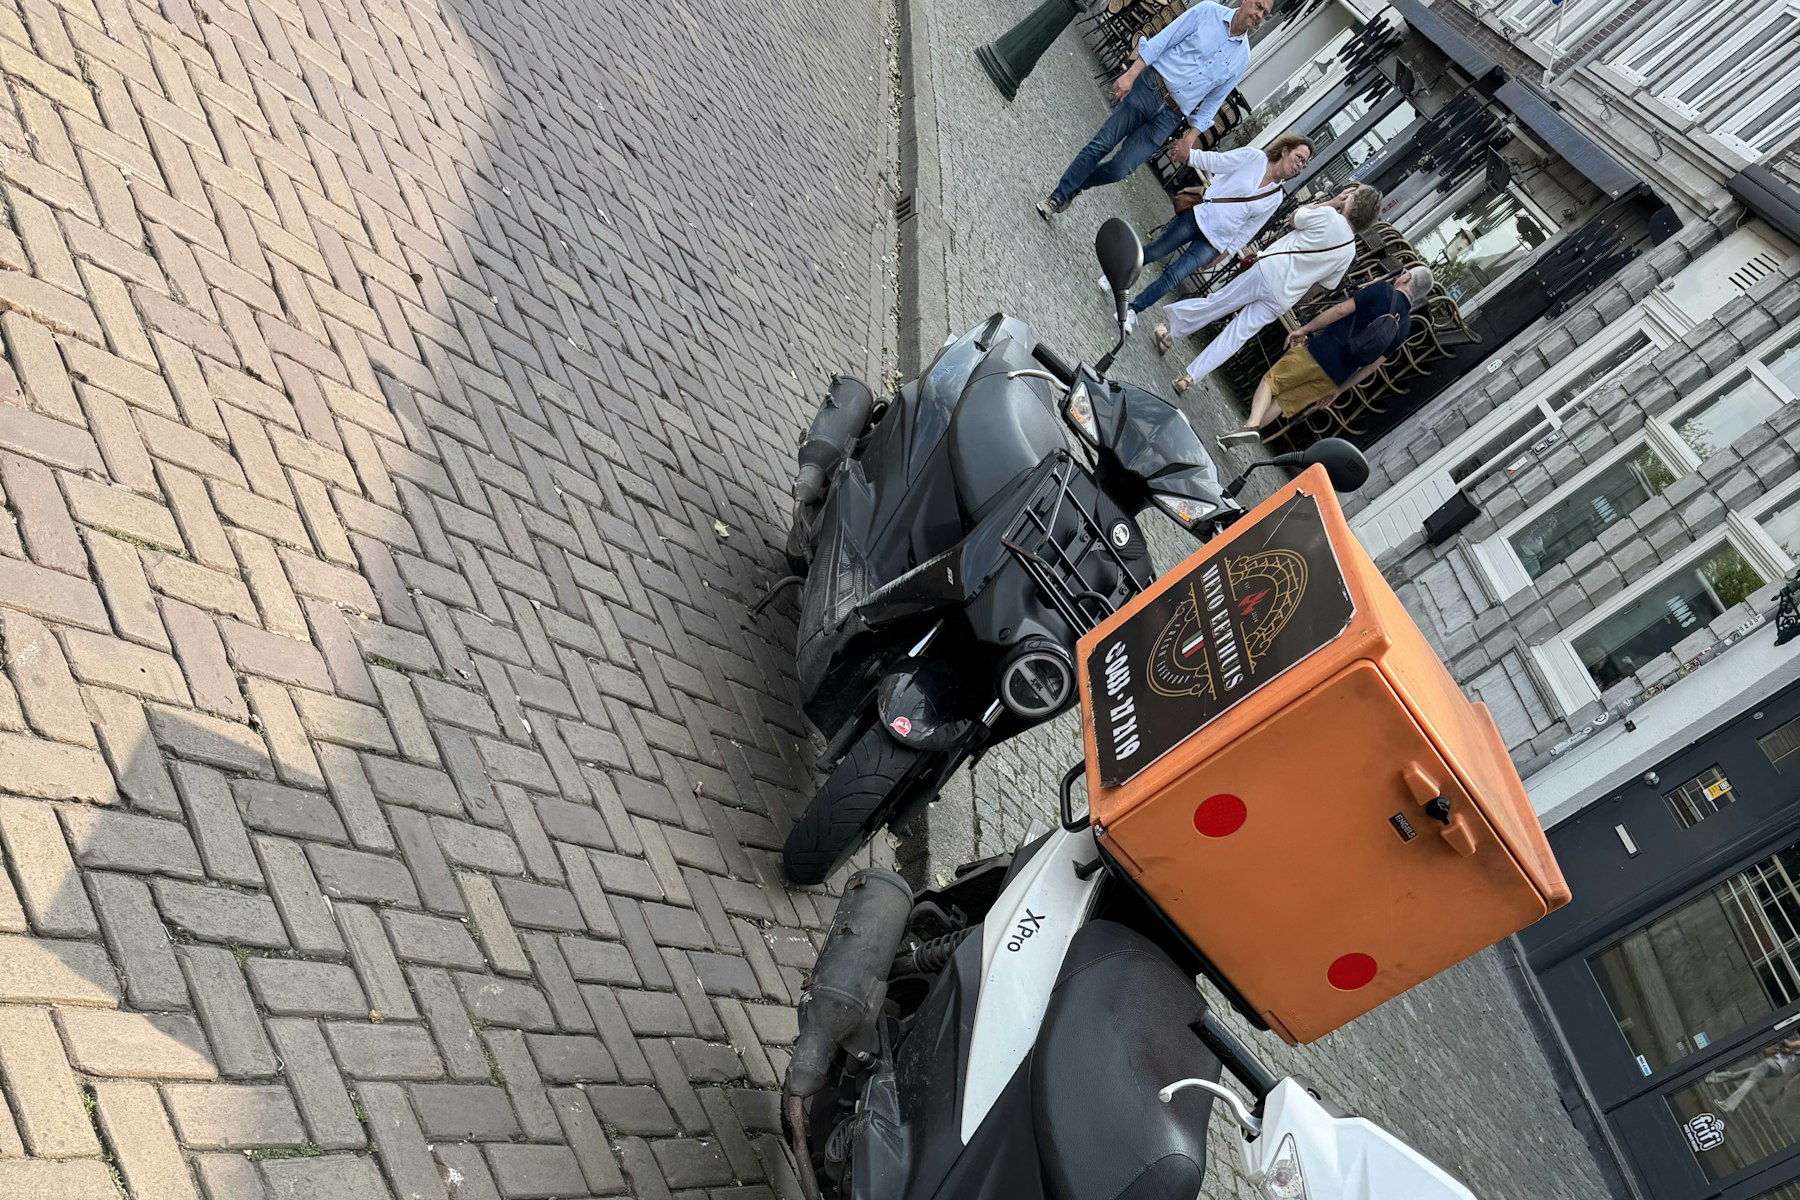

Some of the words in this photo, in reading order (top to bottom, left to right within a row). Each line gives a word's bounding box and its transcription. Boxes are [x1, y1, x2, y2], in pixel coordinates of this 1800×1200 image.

[1201, 563, 1226, 611] MEYO
[1665, 595, 1697, 628] ANNA'S
[1159, 623, 1181, 658] FRESH
[1210, 608, 1244, 691] EETHUIS
[1105, 655, 1131, 696] 0433
[1110, 696, 1135, 723] 27
[1113, 715, 1137, 744] 21
[1115, 734, 1141, 761] 19
[1394, 814, 1416, 839] ENGELS
[1691, 1115, 1722, 1149] frifi
